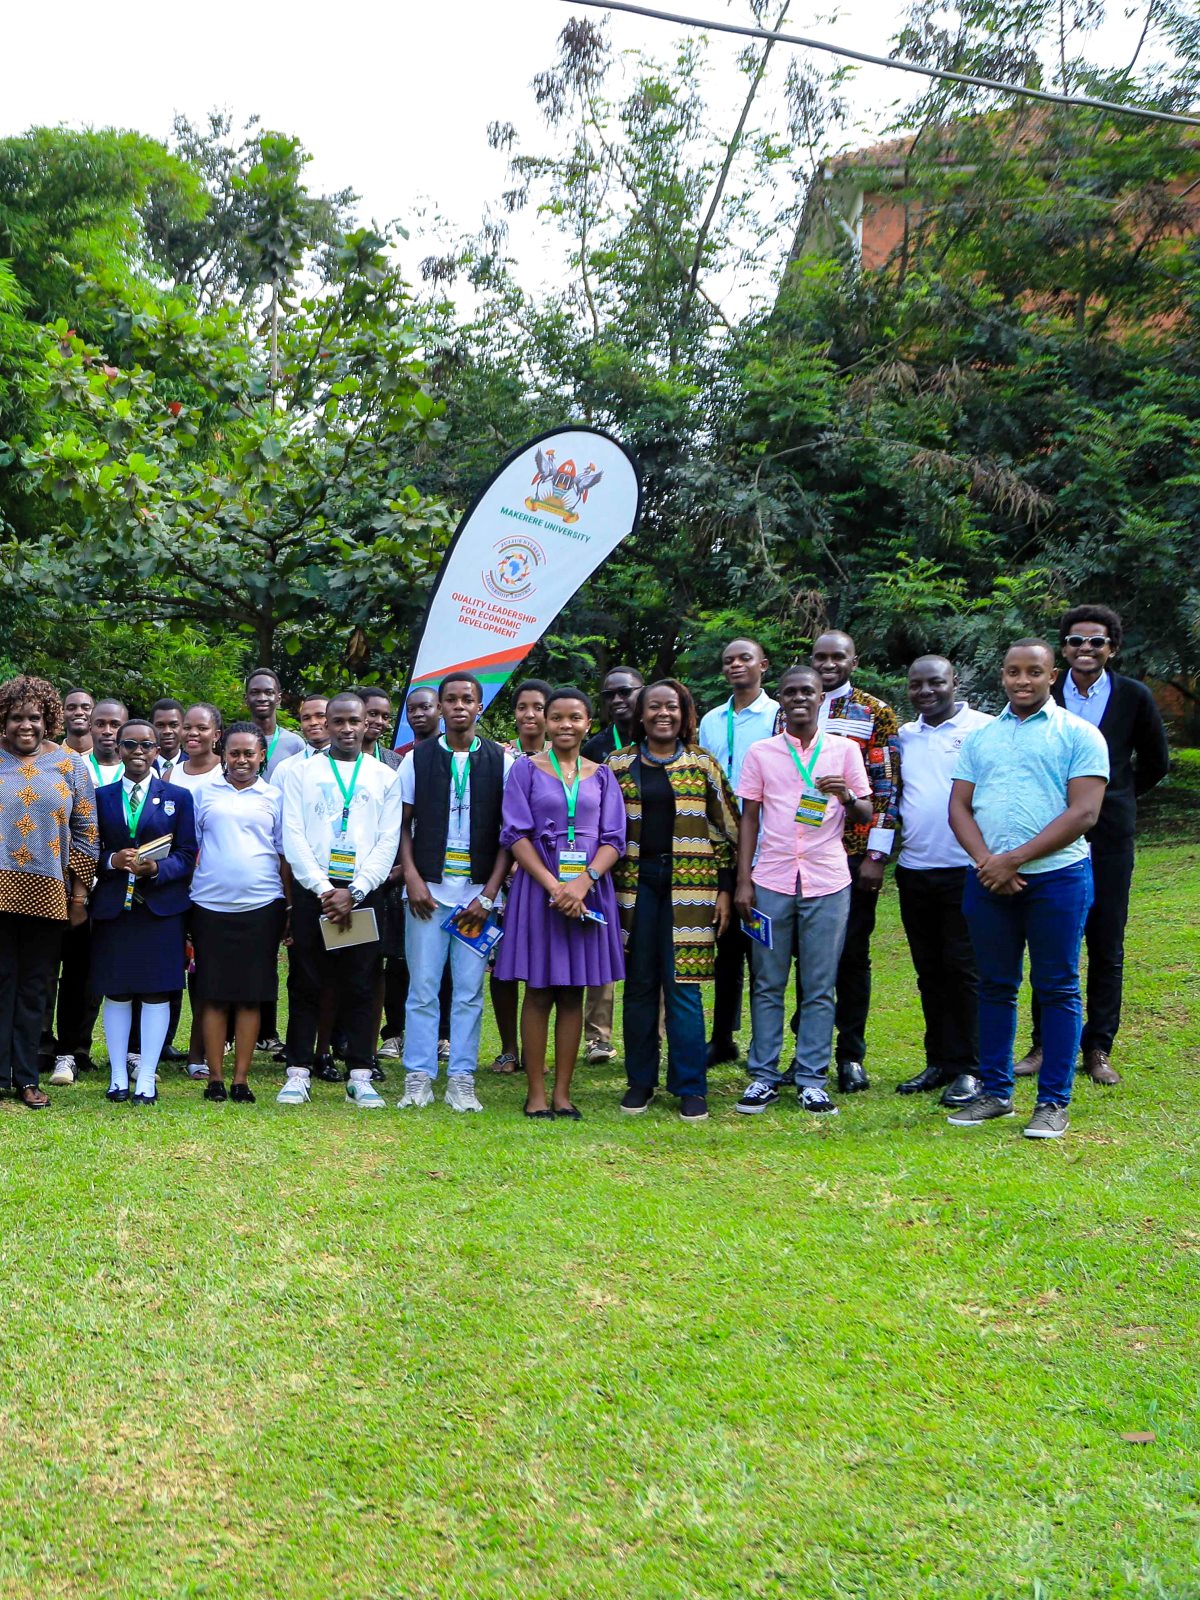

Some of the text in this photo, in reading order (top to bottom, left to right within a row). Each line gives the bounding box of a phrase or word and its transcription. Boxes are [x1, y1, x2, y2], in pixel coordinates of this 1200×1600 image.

[500, 507, 543, 527] MAKERERE
[545, 522, 591, 543] UNIVERSITY
[451, 592, 537, 624] QUALITY LEADERSHIP
[460, 605, 522, 629] FOR ECONOMIC
[458, 615, 518, 639] DEVELOPMENT
